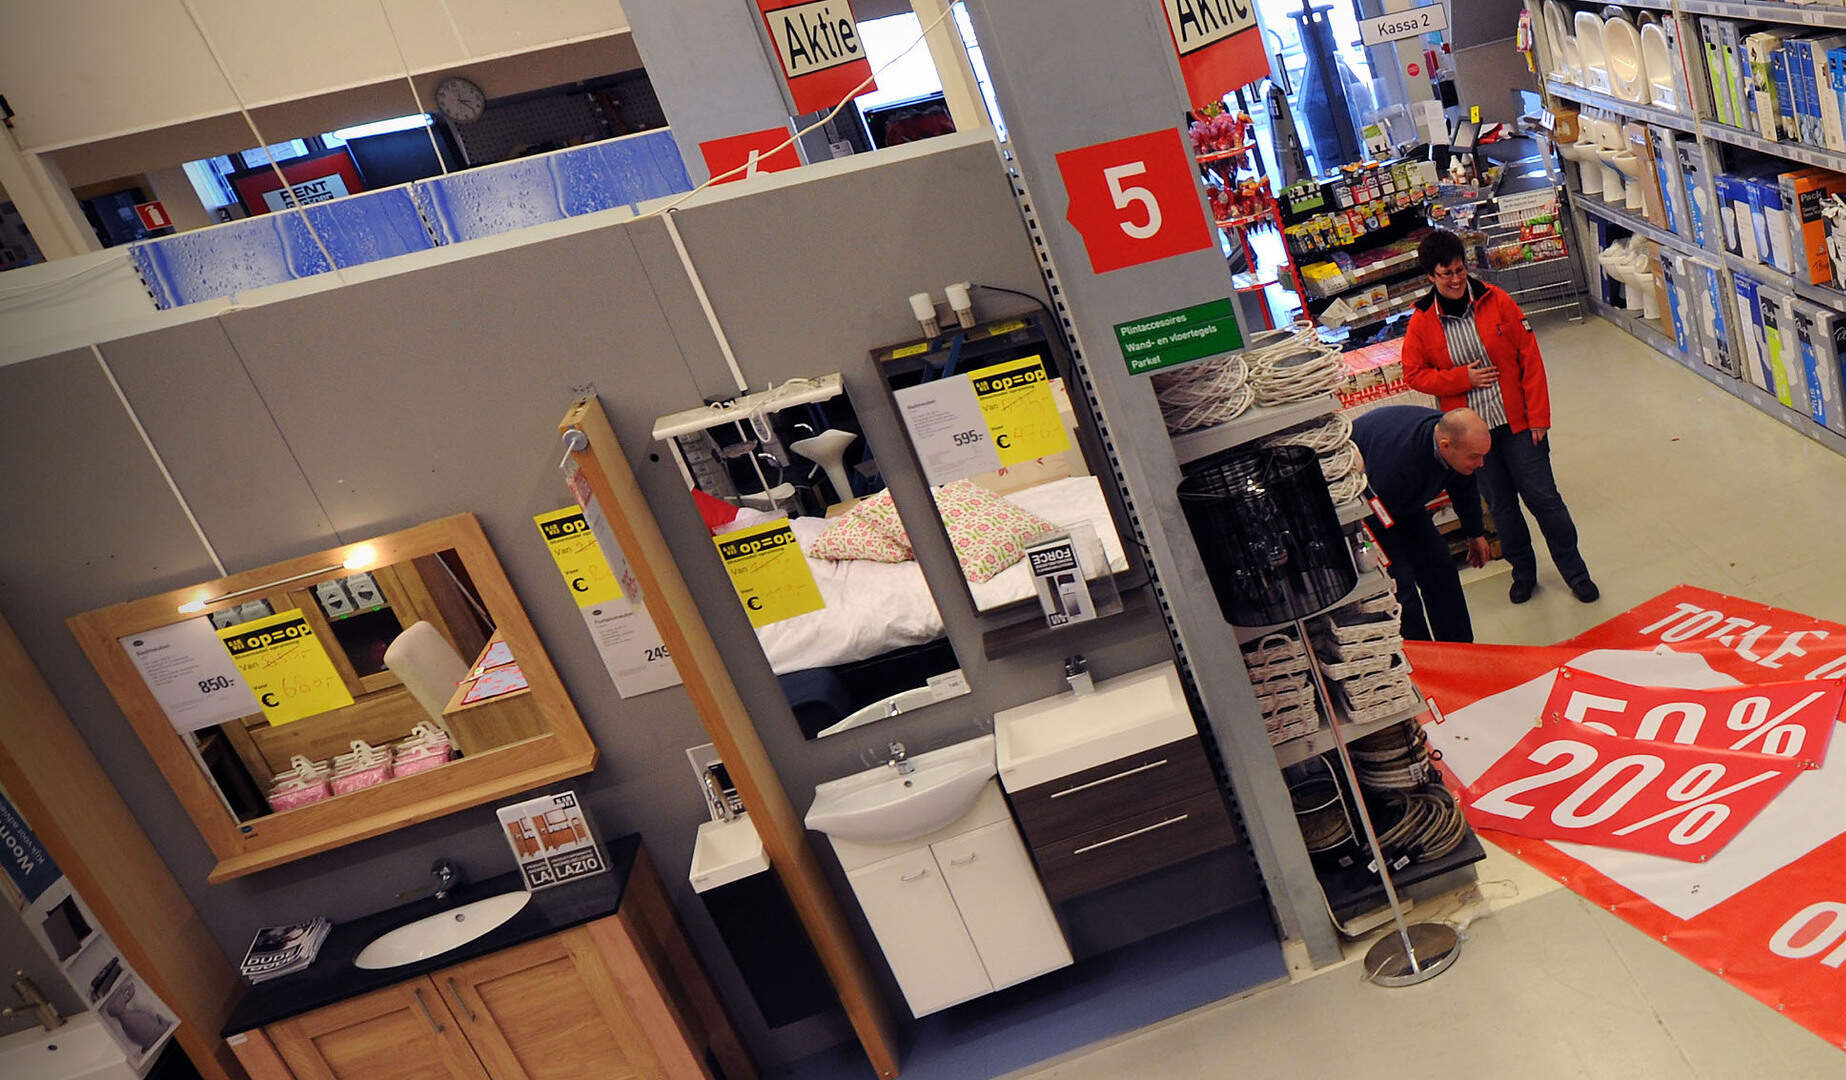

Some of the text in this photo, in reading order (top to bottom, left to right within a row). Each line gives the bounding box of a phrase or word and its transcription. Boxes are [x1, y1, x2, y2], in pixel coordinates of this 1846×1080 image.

[1378, 13, 1431, 36] Kassa 2
[784, 8, 858, 69] Aktie
[1103, 161, 1162, 239] 5
[1120, 313, 1187, 336] Plintaccesoires
[1156, 335, 1168, 346] en
[1169, 324, 1218, 344] vloertegels
[1131, 354, 1161, 370] Parket
[992, 369, 1046, 391] op=op
[996, 434, 1011, 448] €
[739, 531, 796, 554] op=op
[1031, 547, 1073, 565] FORCE
[572, 577, 589, 592] €
[747, 596, 763, 611] €
[247, 623, 310, 649] op=op
[261, 692, 280, 707] €
[1565, 690, 1826, 757] 50%
[1470, 739, 1782, 845] 20%
[555, 857, 599, 878] LAZIO
